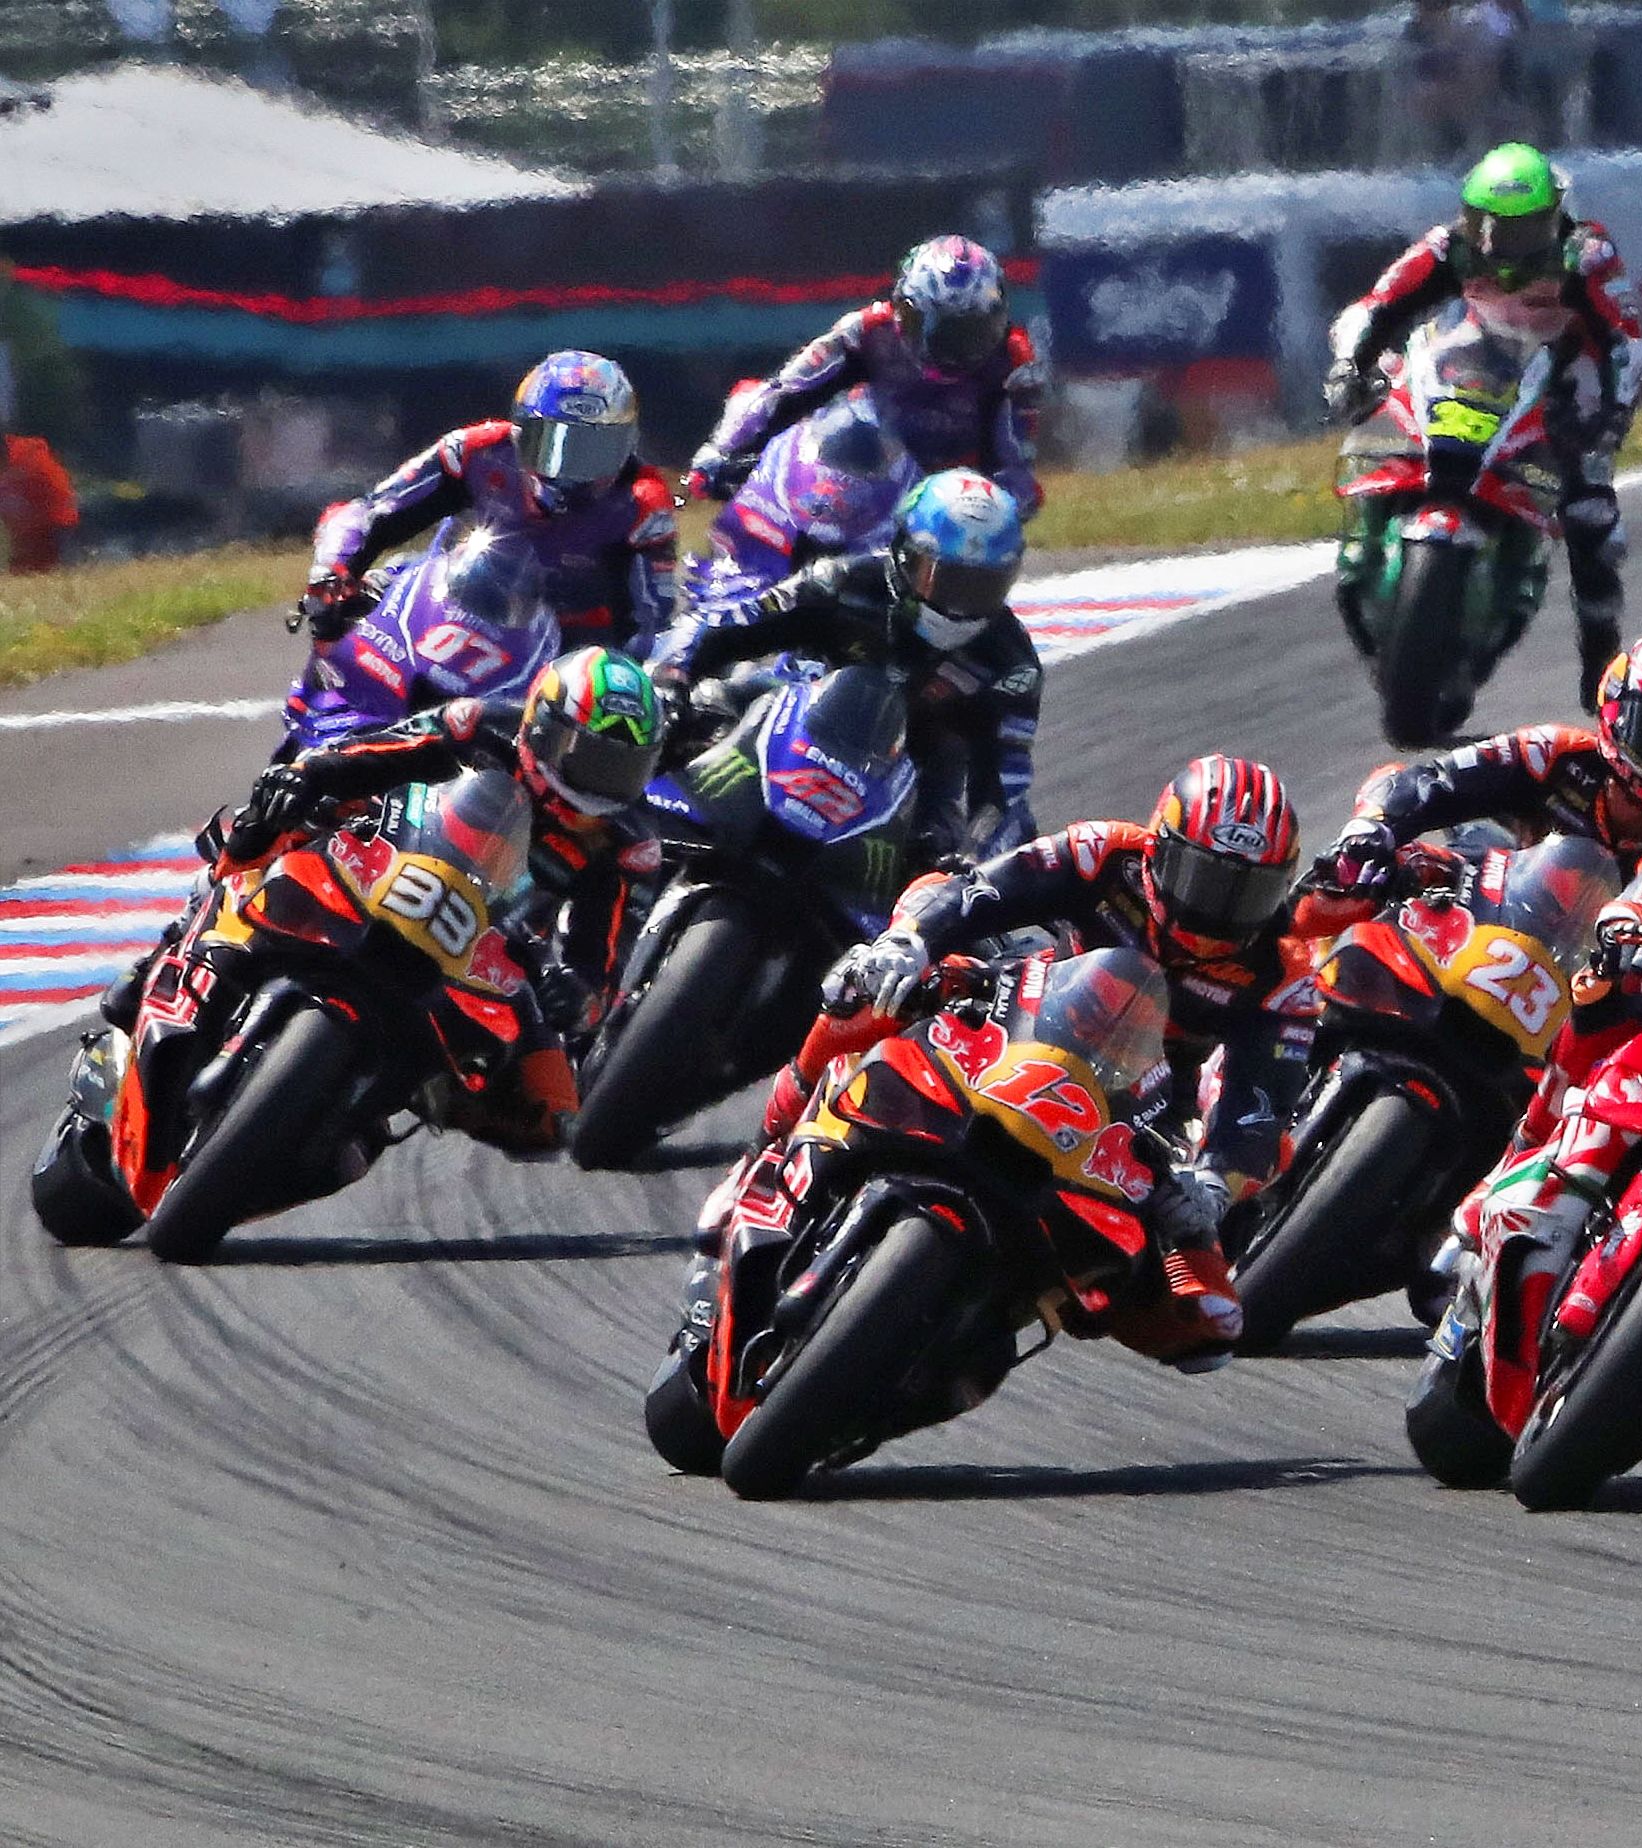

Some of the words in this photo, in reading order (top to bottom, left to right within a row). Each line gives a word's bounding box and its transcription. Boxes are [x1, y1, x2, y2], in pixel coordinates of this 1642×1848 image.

[414, 622, 511, 683] 07
[378, 862, 478, 958] 33
[1022, 957, 1047, 999] MOTUL
[1464, 938, 1561, 1036] 23
[978, 1060, 1101, 1135] 12
